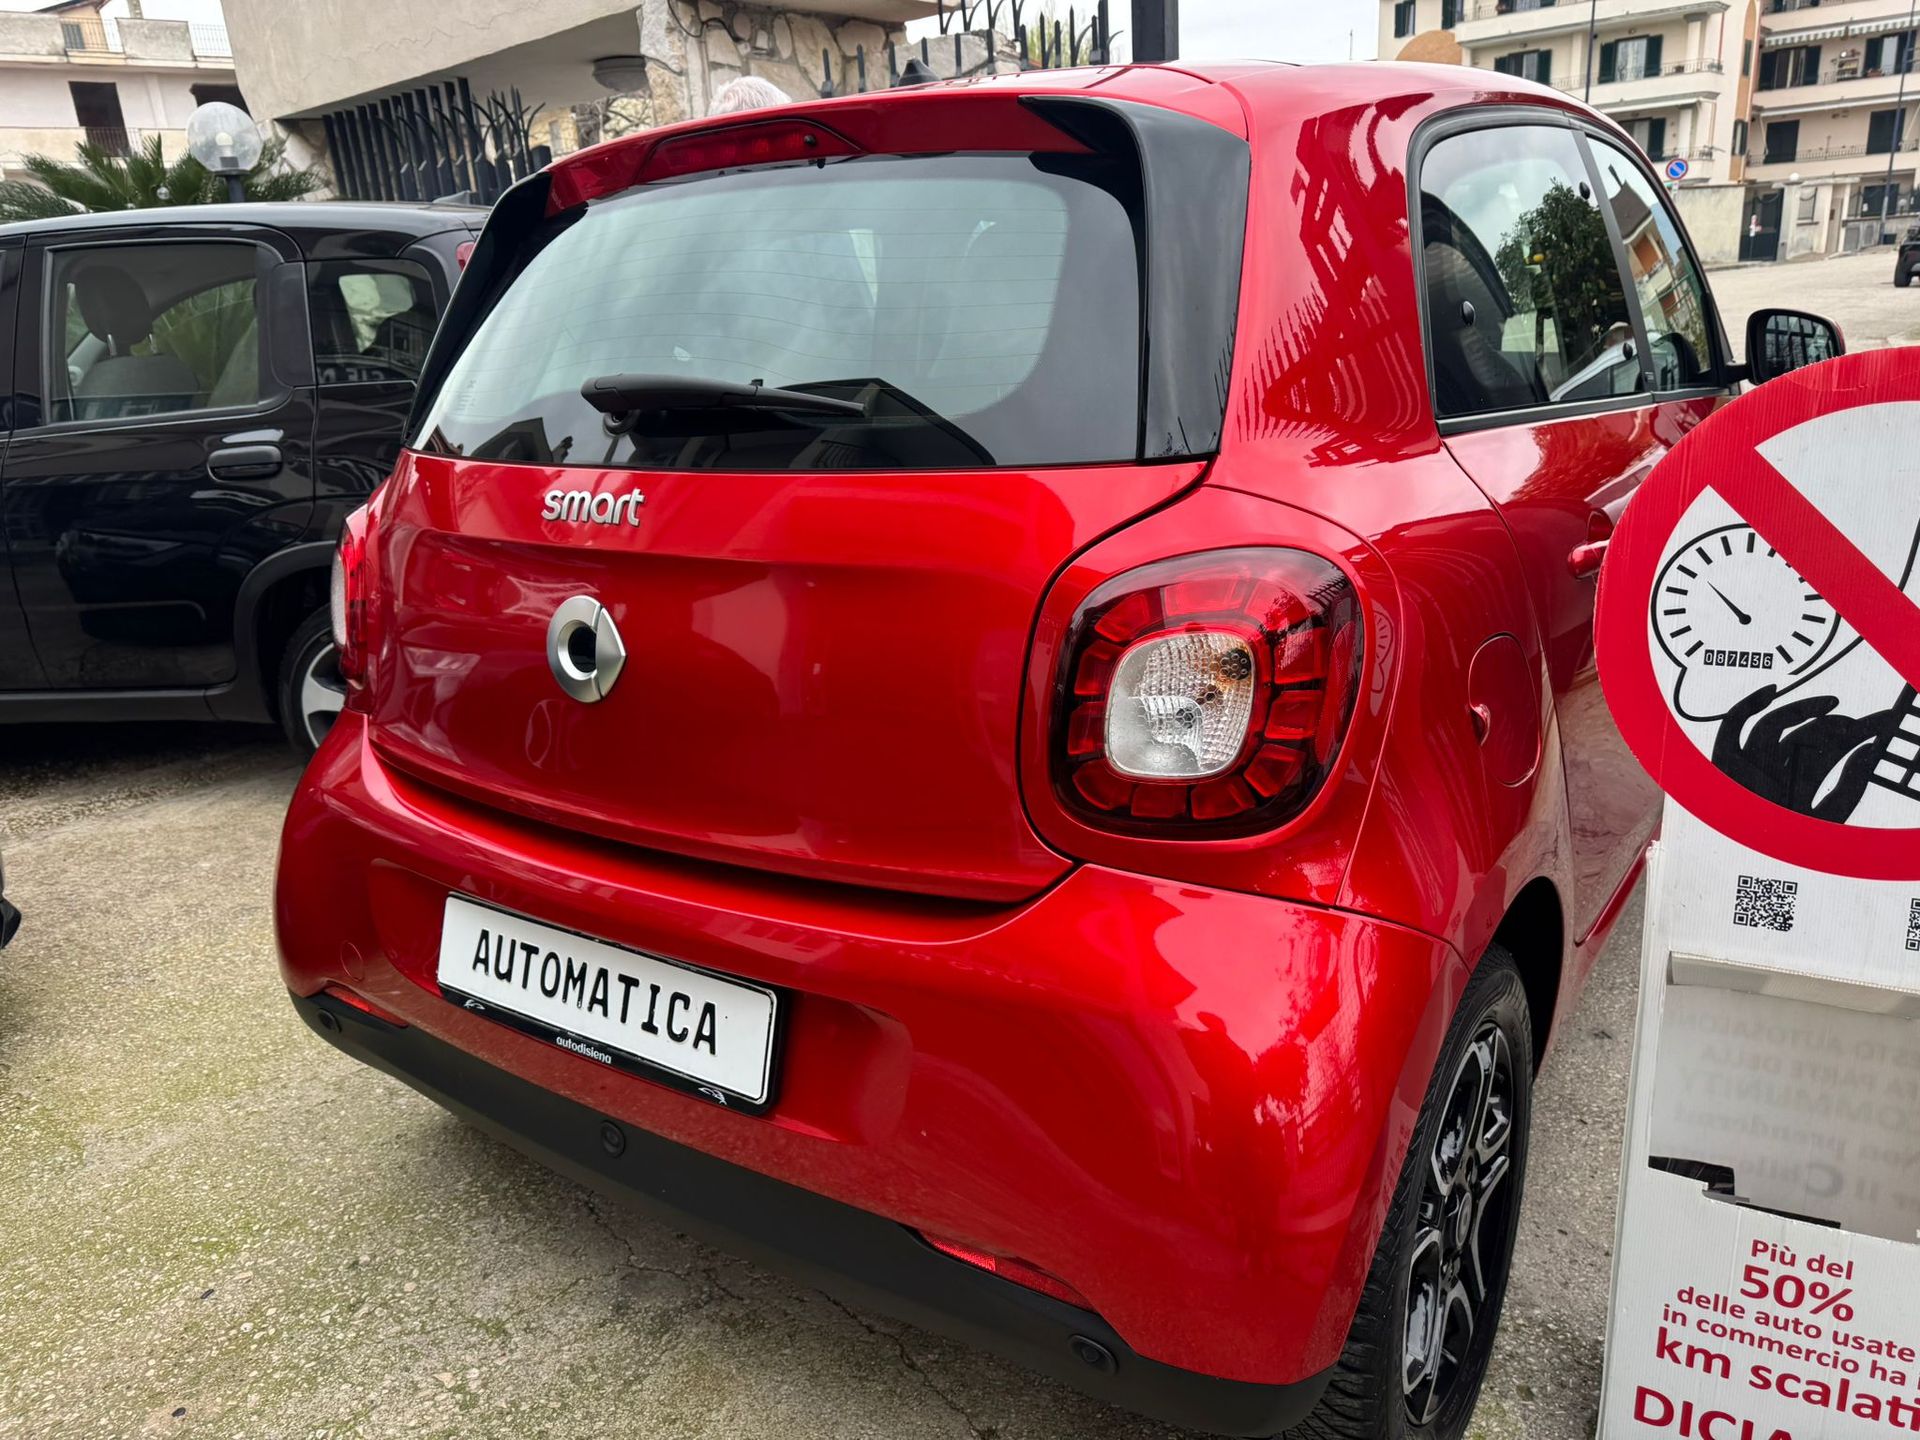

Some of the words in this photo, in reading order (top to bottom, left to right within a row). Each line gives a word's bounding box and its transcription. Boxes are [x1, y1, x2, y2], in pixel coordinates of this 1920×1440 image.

[541, 487, 645, 527] smart
[1705, 650, 1772, 669] 087436
[472, 929, 718, 1056] AUTOMATICA
[1751, 1239, 1796, 1267] Più
[1807, 1254, 1853, 1280] del
[1740, 1264, 1854, 1322] 50%
[1662, 1304, 1687, 1326] in
[1696, 1318, 1859, 1374] commercio
[1869, 1360, 1906, 1386] ha
[1677, 1286, 1745, 1319] delle
[1754, 1311, 1822, 1339] auto
[1832, 1330, 1916, 1362] usate
[1655, 1326, 1731, 1379] km
